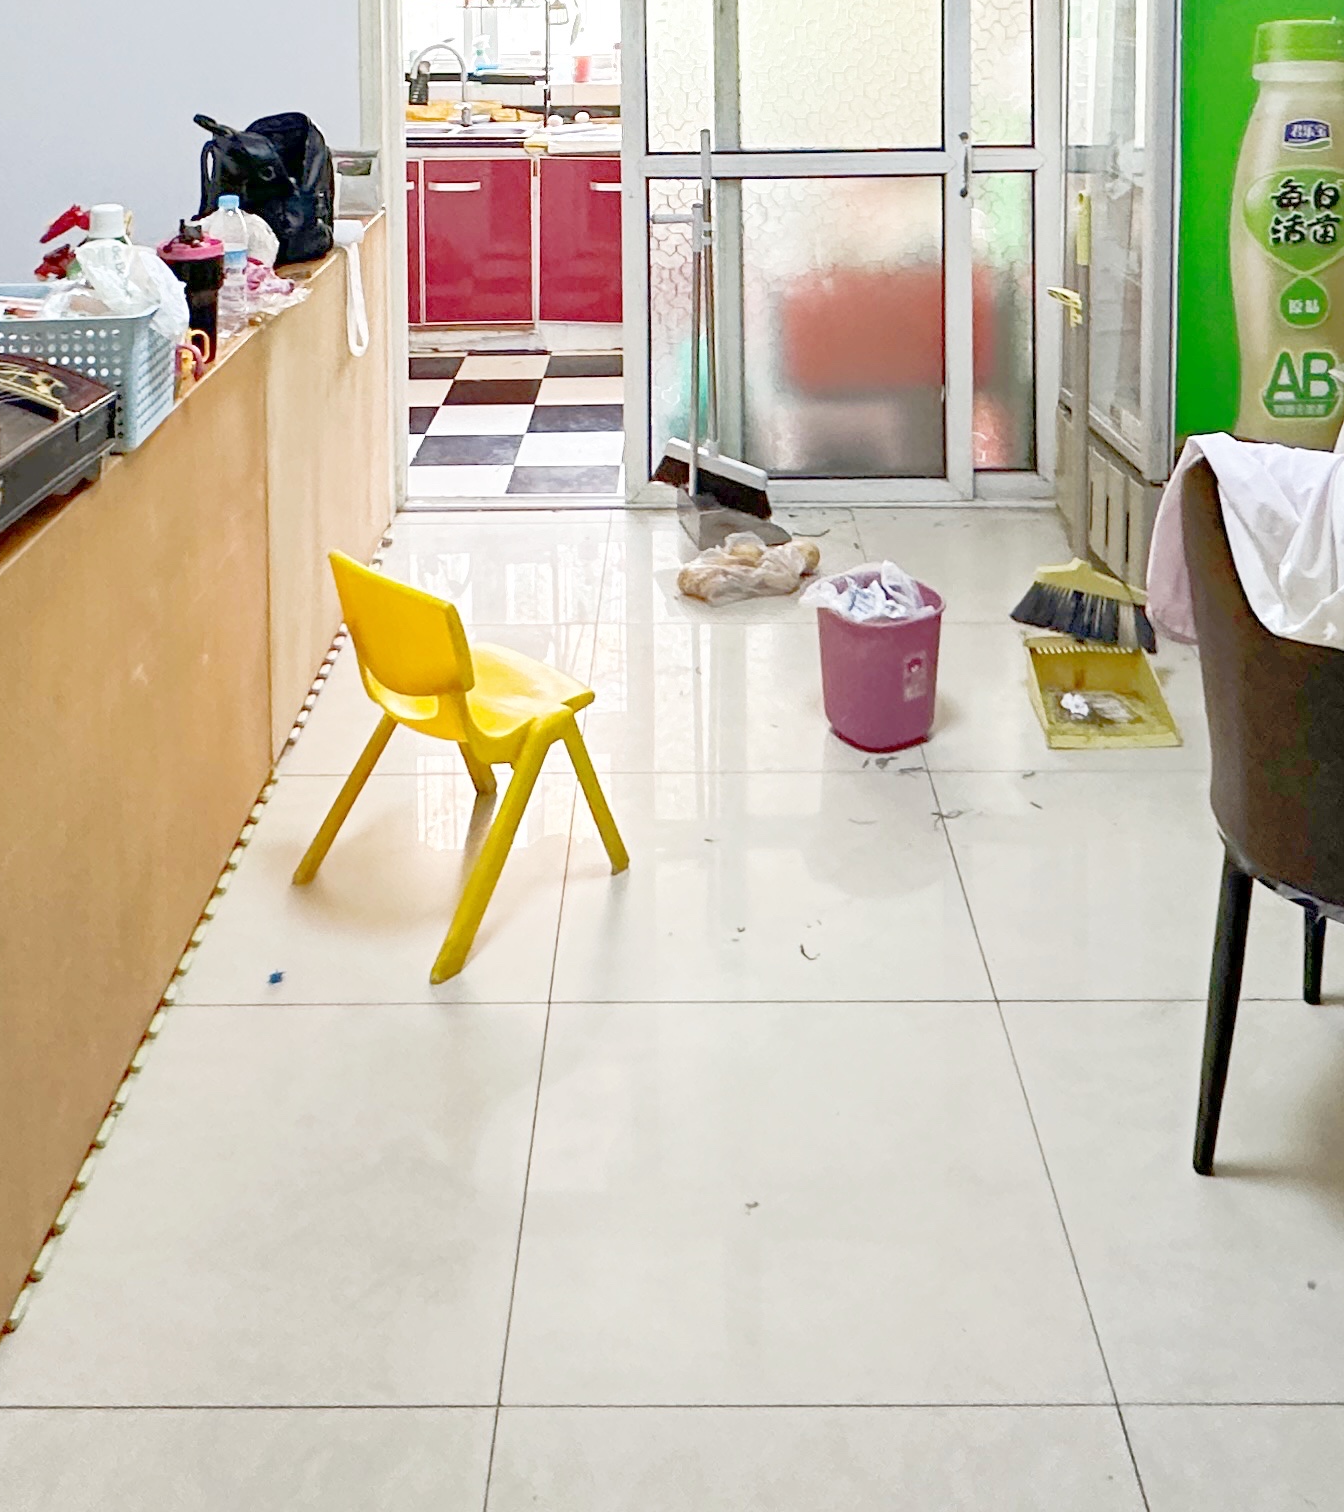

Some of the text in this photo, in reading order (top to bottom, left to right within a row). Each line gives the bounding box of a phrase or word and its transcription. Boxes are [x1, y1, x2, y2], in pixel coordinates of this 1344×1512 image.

[1271, 178, 1341, 210] 每日
[1271, 213, 1342, 244] 活菌
[1265, 350, 1338, 400] AB
